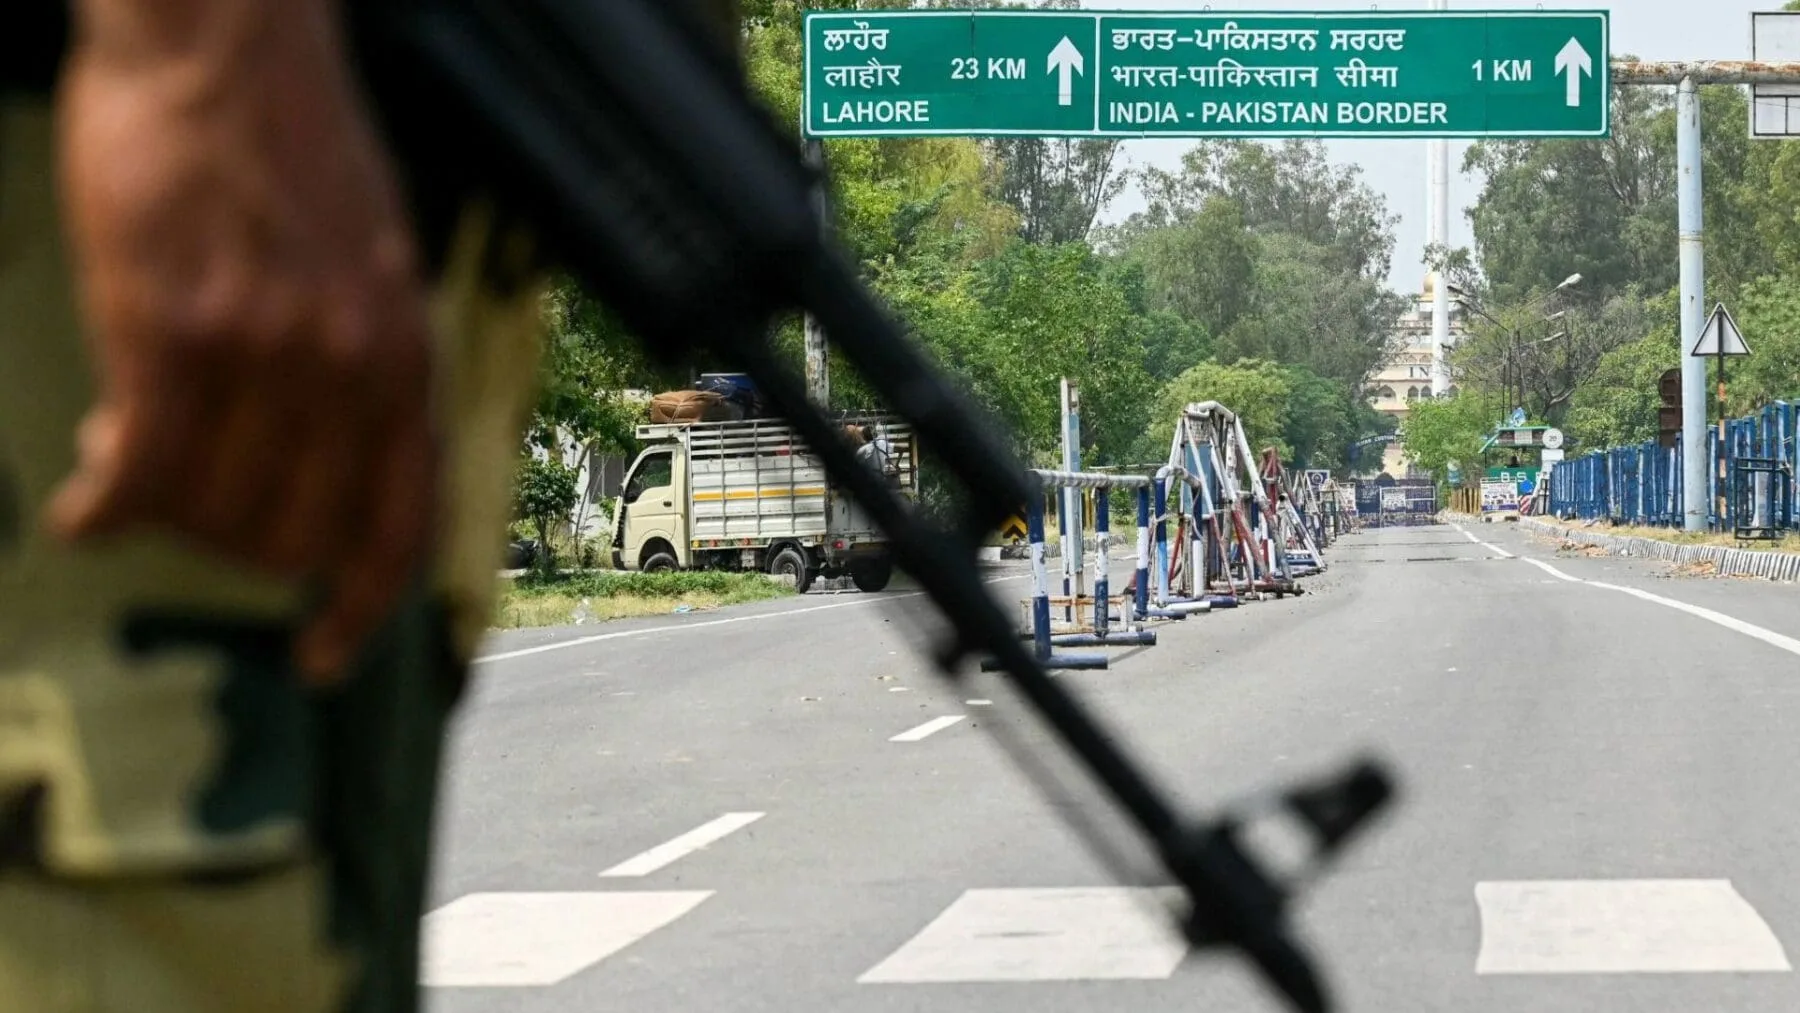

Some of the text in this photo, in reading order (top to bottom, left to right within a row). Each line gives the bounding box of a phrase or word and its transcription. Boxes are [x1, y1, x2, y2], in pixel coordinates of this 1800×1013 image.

[824, 21, 889, 51] ਲਾਹੌਰ
[1330, 29, 1405, 51] ਸਰਹਦ
[823, 57, 902, 89] लाहौर
[951, 57, 1026, 79] 23 KM
[1111, 58, 1398, 87] भारत-पाकिस्तान सीमा
[1472, 59, 1532, 81] 1 KM
[823, 100, 930, 123] LAHORE
[1110, 102, 1179, 124] INDIA
[1202, 102, 1328, 124] PAKISTAN
[1337, 102, 1448, 124] BORDER
